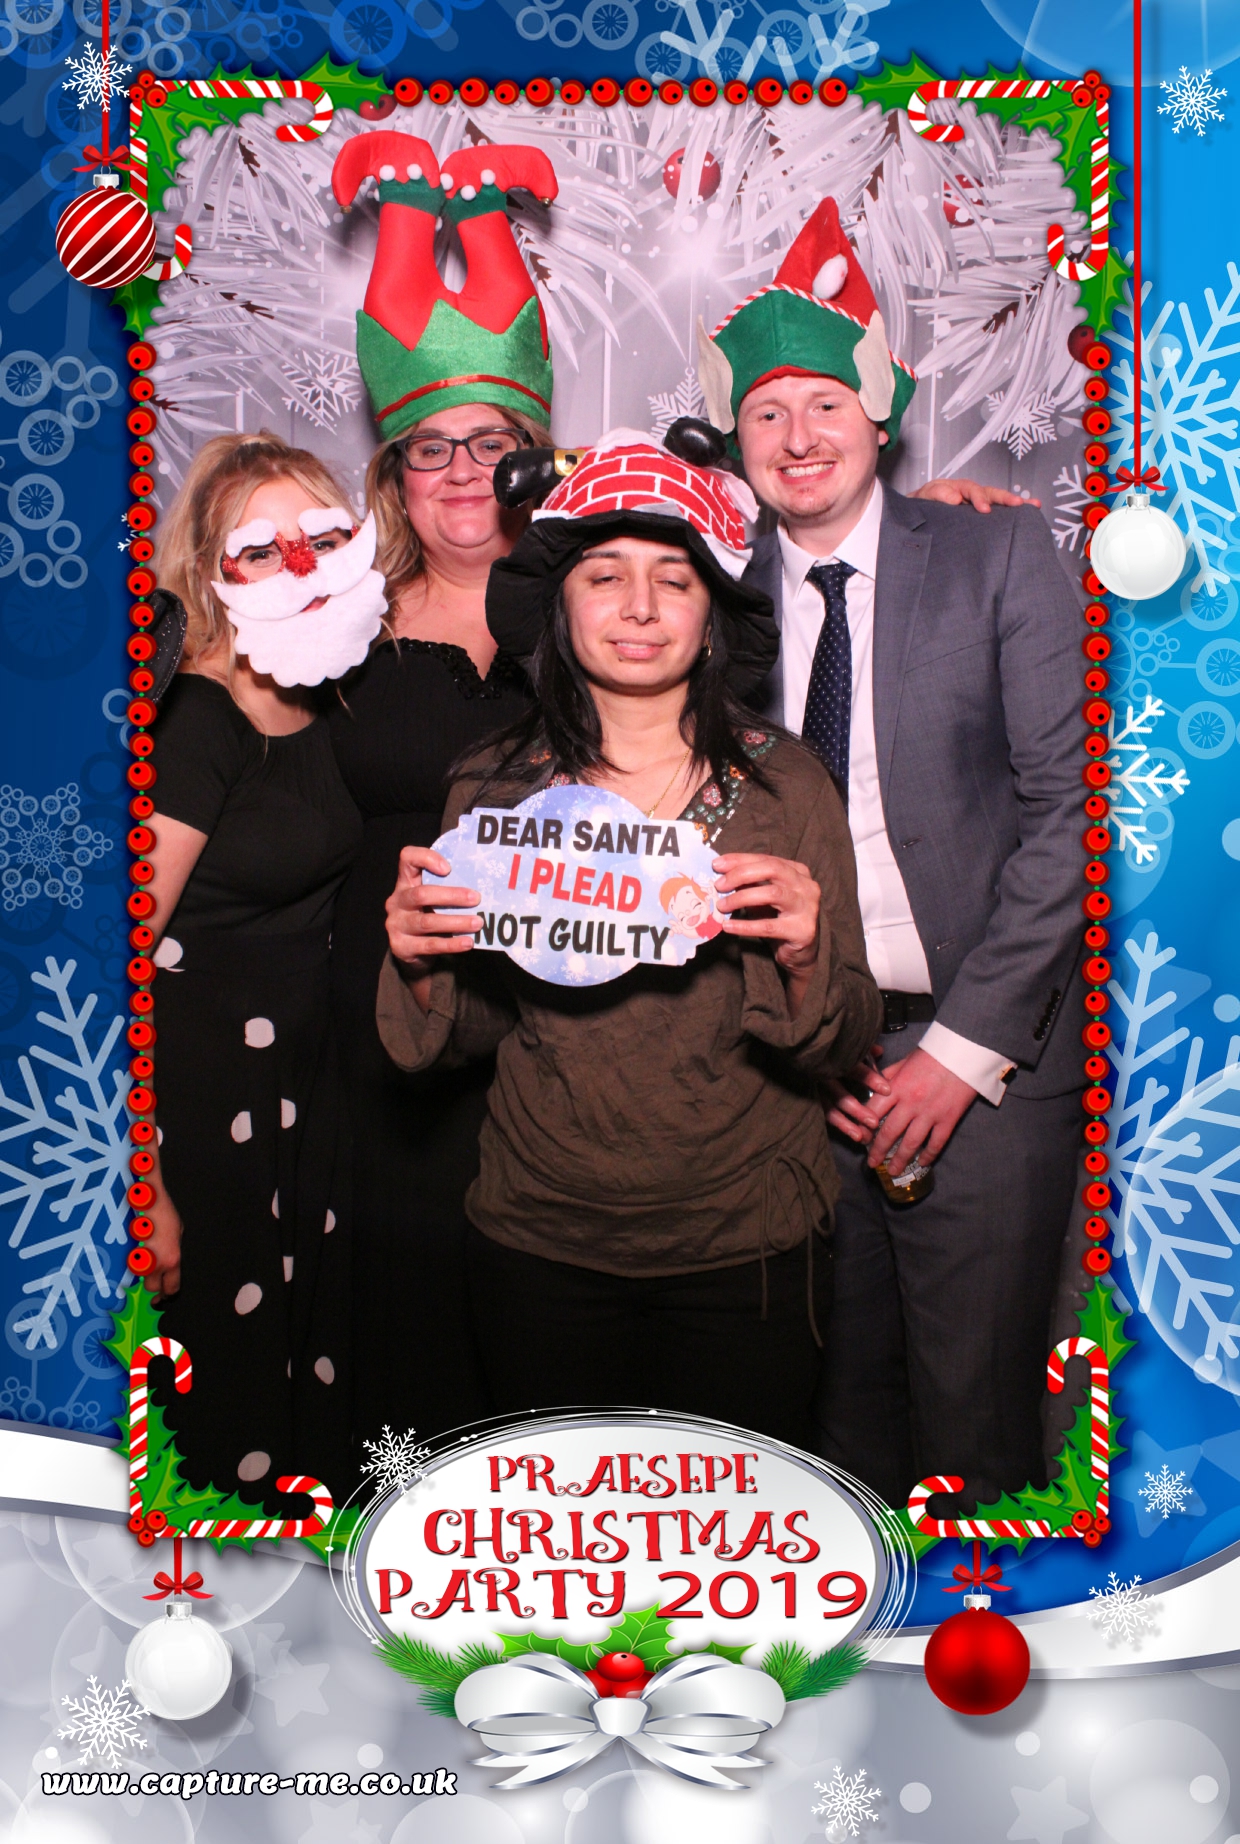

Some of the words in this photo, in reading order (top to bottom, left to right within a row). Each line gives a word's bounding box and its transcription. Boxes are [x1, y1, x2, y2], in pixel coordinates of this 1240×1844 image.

[476, 814, 563, 849] DEAR
[572, 819, 681, 857] SANTA
[507, 853, 522, 890] I
[529, 857, 642, 914] PLEAD
[473, 911, 541, 949] NOT
[548, 917, 670, 960] GUILTY
